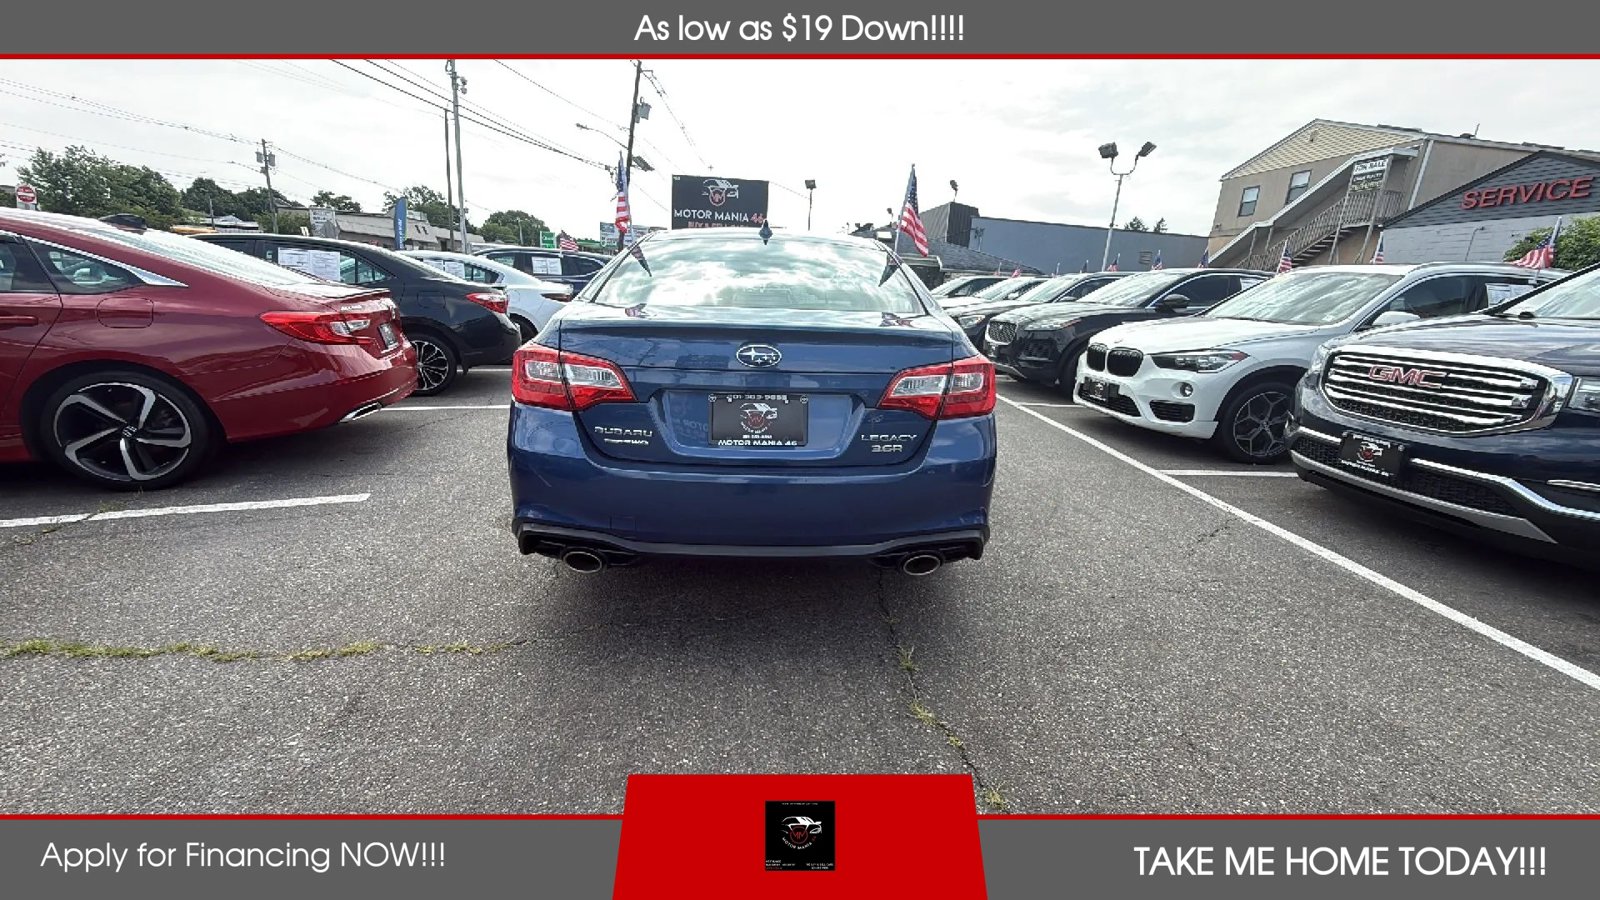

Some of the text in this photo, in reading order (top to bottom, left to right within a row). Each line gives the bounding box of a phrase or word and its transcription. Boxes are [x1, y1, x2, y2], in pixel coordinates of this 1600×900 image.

[1460, 175, 1596, 211] SERVICE
[674, 208, 764, 223] MOTOR MANIA 46
[1368, 364, 1448, 389] GMC
[594, 426, 653, 437] SUBARU
